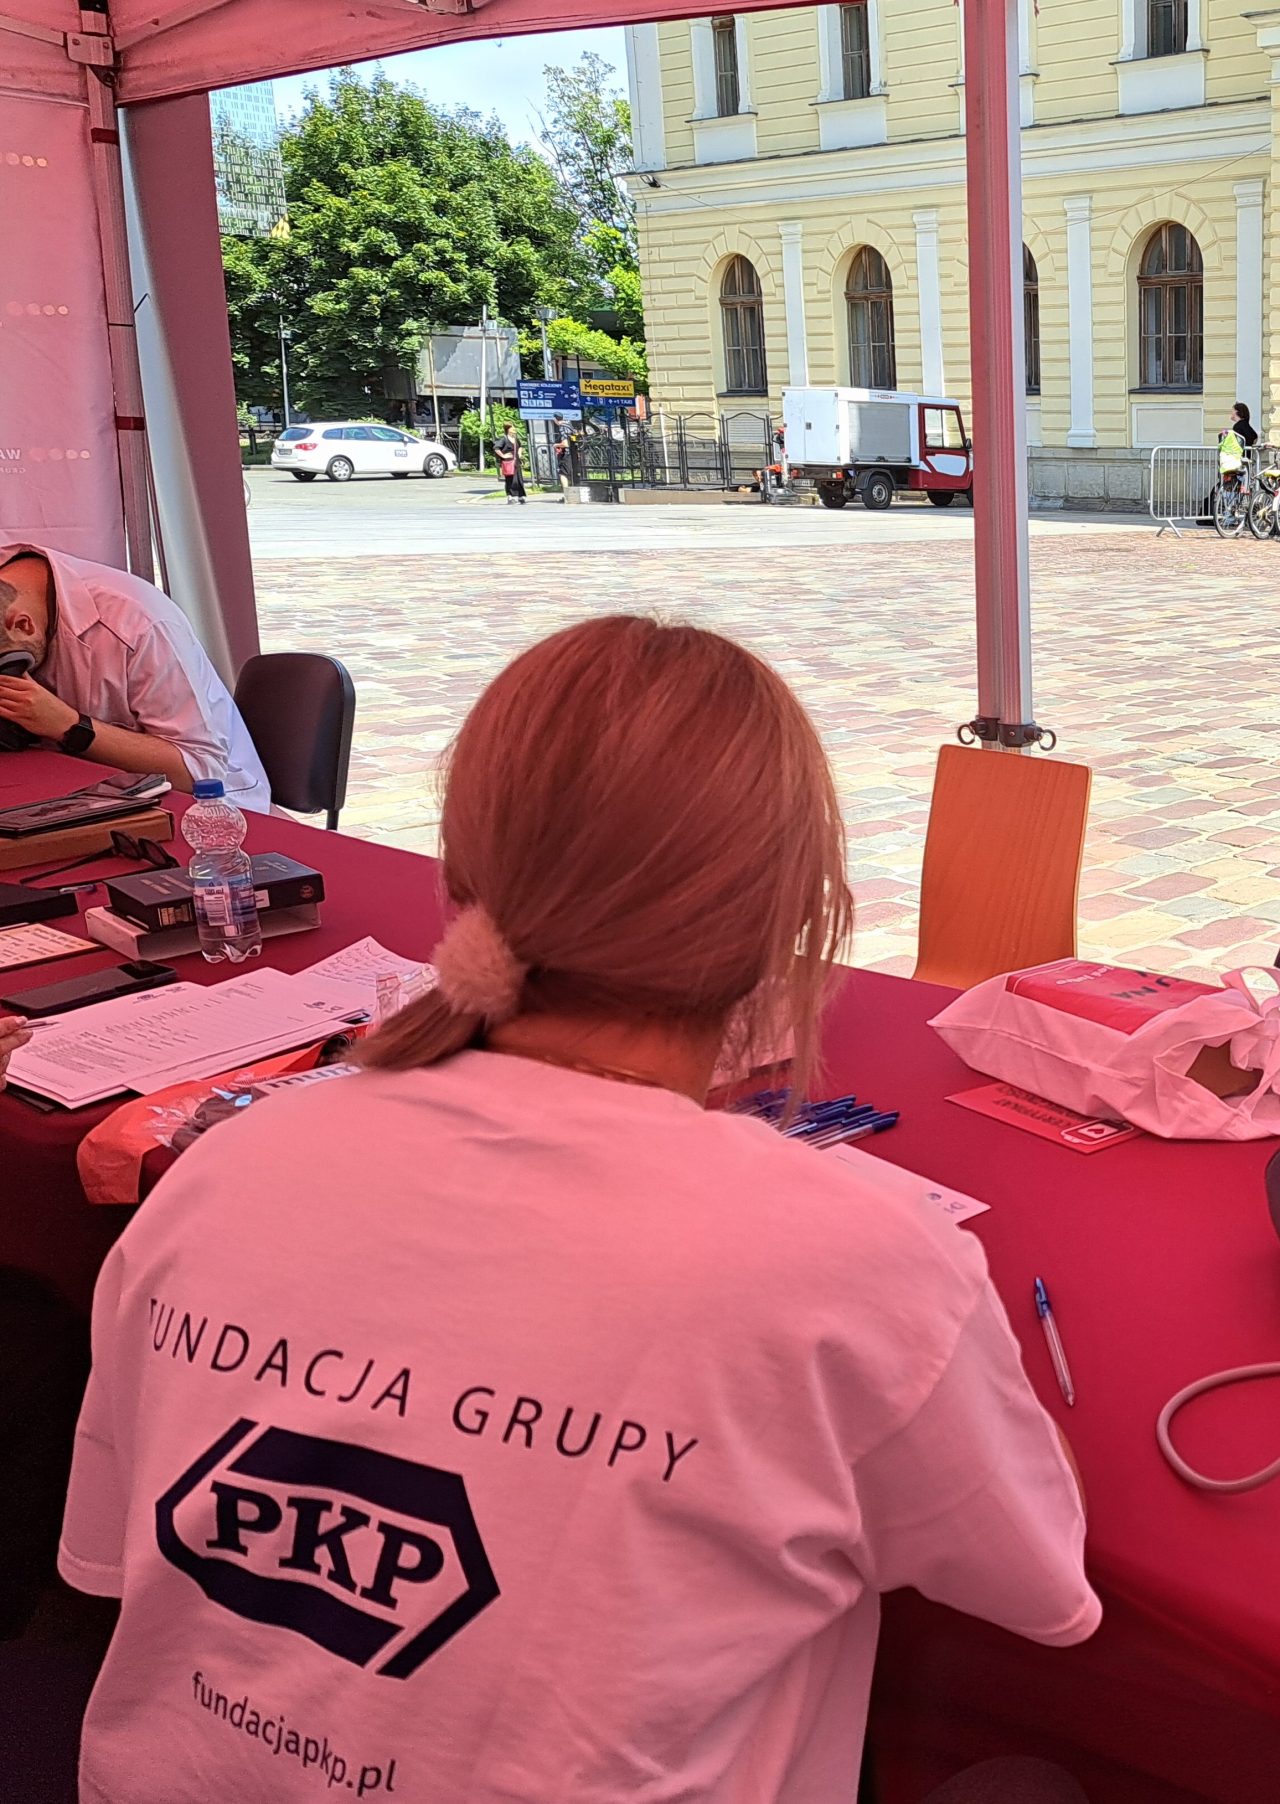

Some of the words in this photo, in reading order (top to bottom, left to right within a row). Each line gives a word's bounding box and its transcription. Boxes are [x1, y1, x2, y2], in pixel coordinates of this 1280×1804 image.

[584, 380, 630, 393] Megataxi
[452, 1385, 699, 1483] GRUPY
[206, 1480, 445, 1611] PKP
[192, 1670, 397, 1797] fundacjapkp.pl
